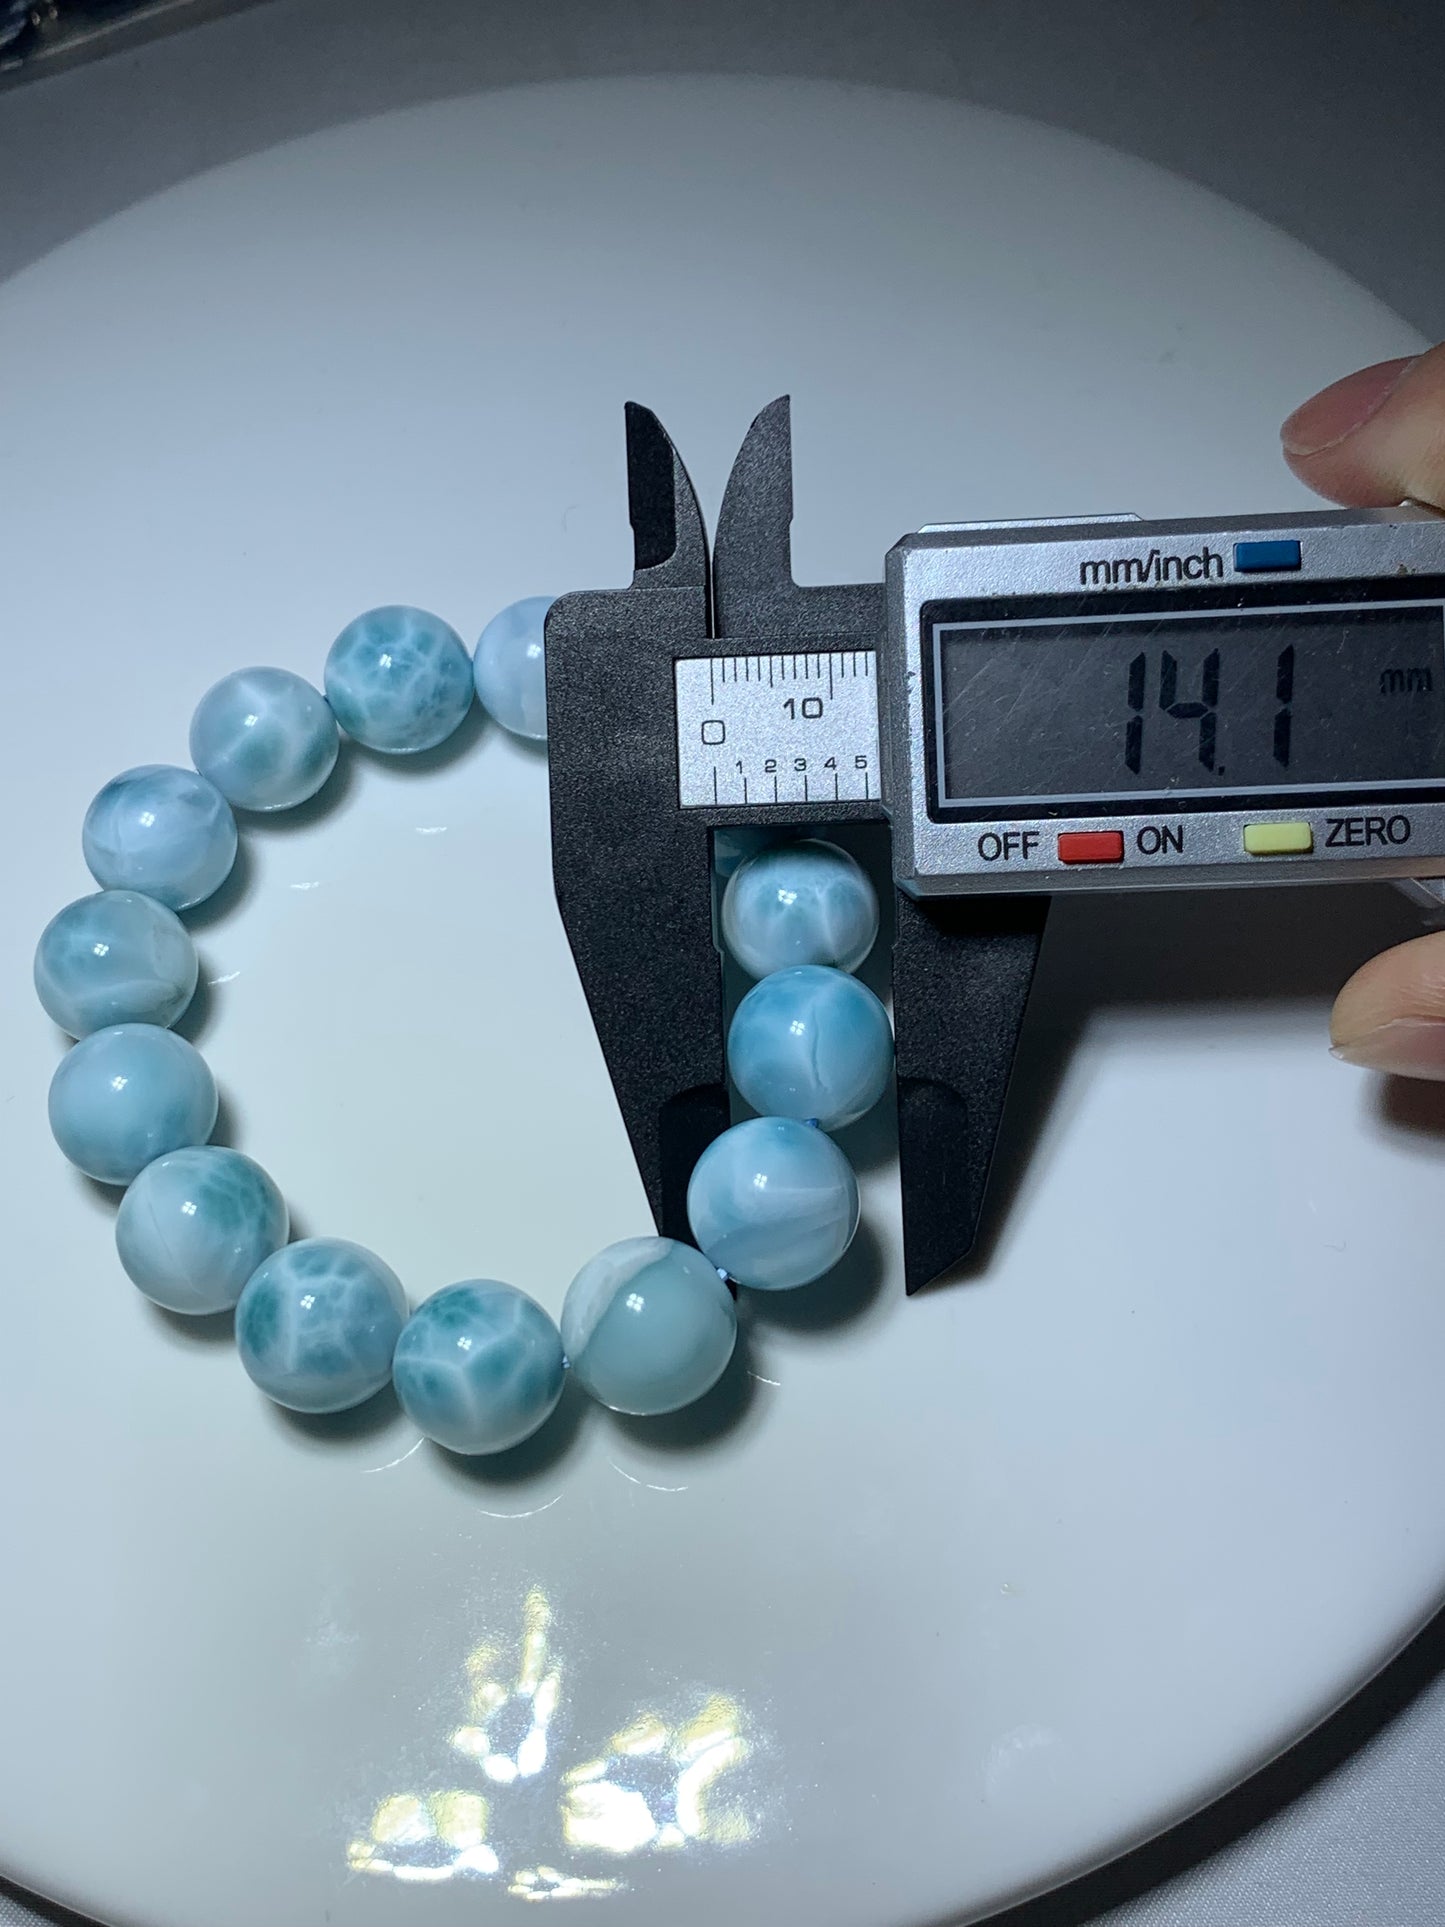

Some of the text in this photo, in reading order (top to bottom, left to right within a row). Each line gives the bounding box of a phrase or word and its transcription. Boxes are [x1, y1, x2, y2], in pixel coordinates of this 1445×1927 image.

[1079, 547, 1224, 586] mm/inch
[783, 696, 823, 720] 10
[1124, 644, 1433, 775] 14.1 mm
[701, 719, 726, 745] 0
[735, 755, 868, 775] 1 2 3 4 5
[977, 814, 1411, 861] OFF ON ZERO
